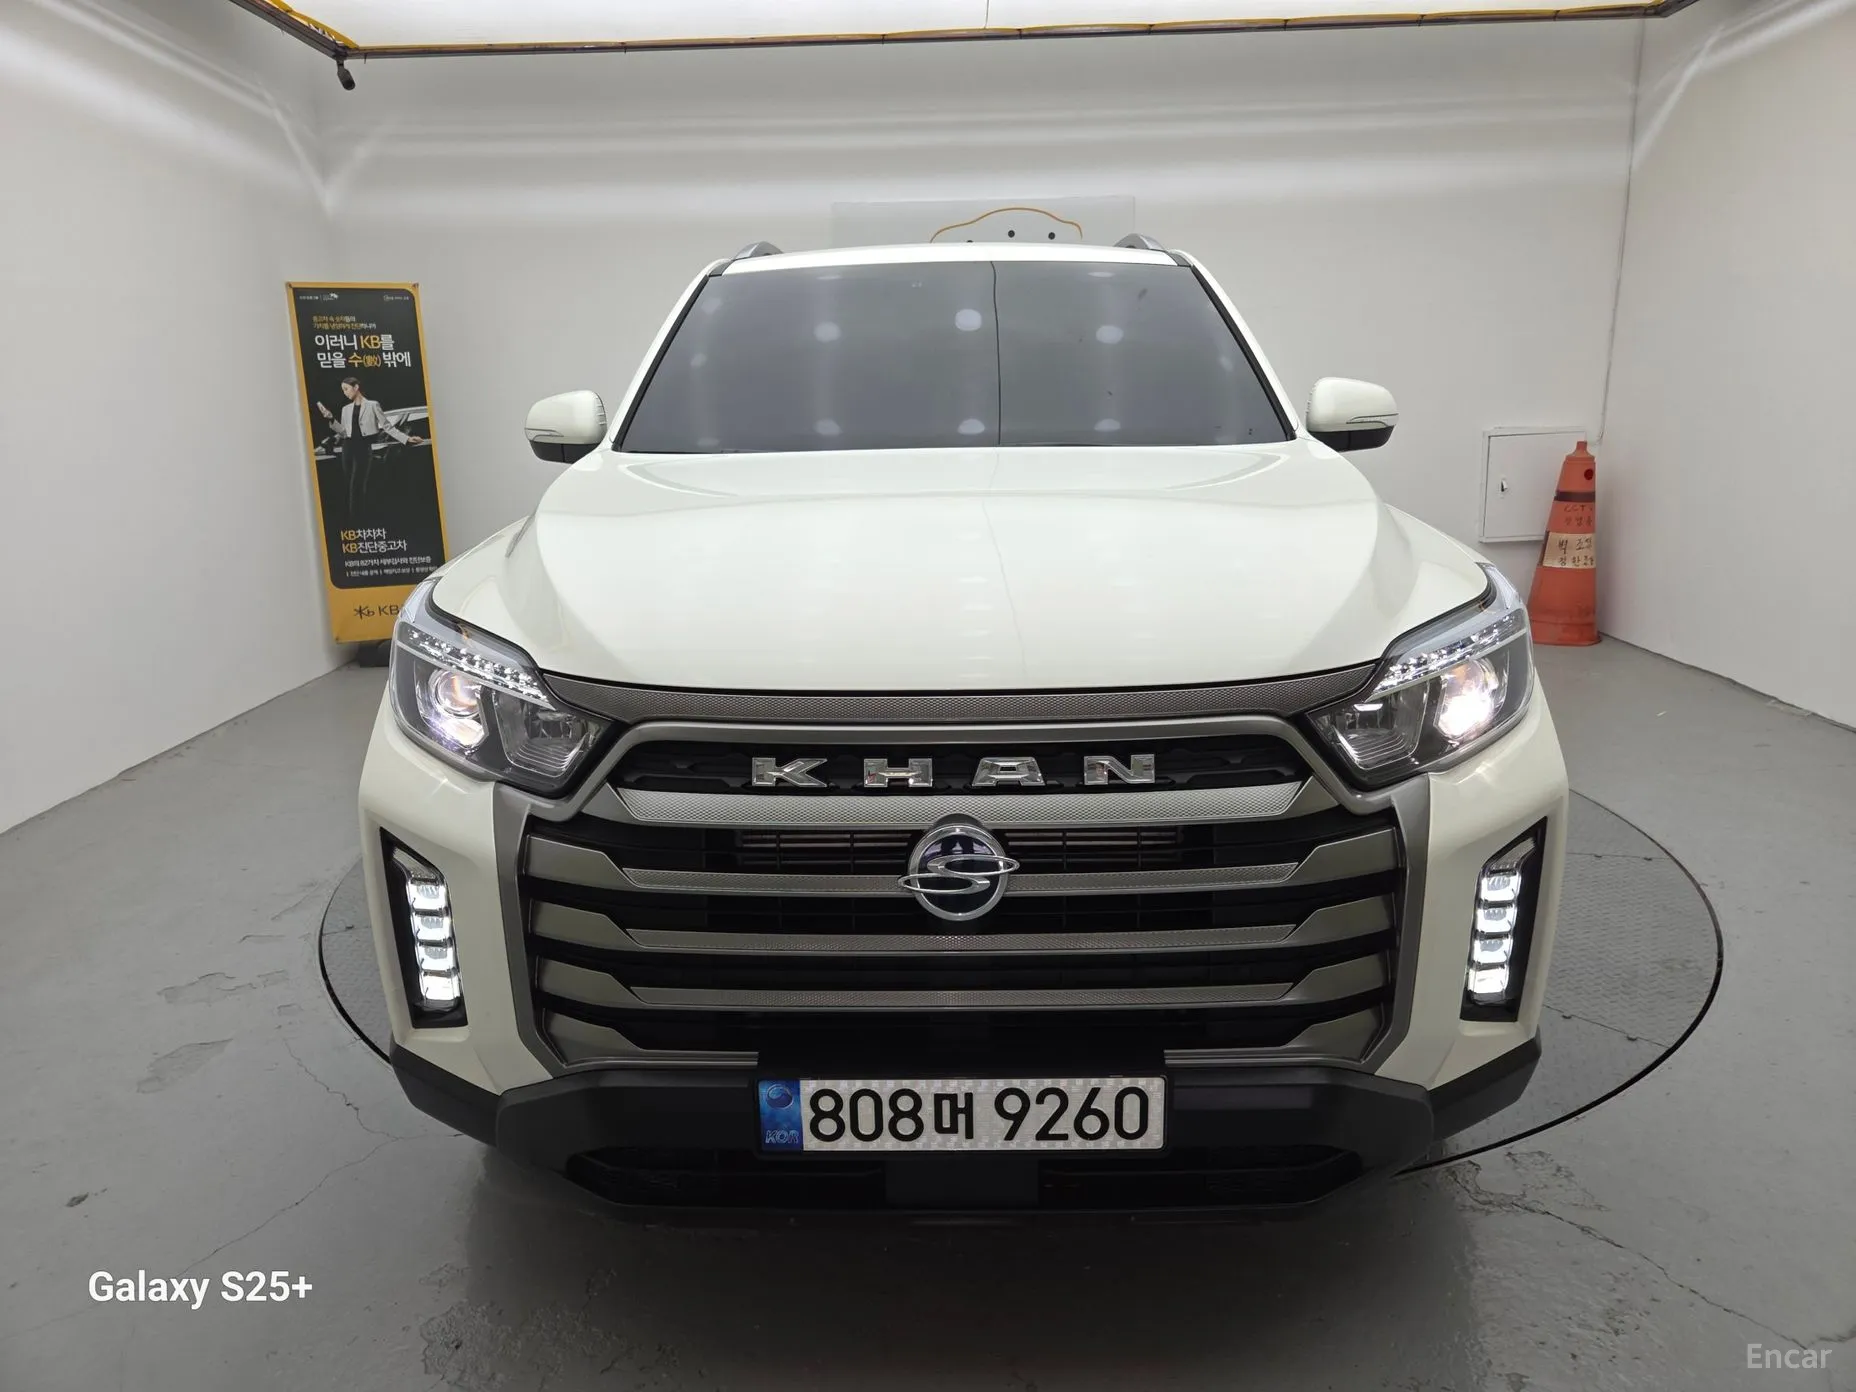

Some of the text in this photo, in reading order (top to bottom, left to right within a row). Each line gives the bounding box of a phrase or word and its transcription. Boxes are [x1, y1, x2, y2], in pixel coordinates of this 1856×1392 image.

[314, 334, 395, 351] 이러니 KB를
[317, 352, 347, 369] 믿을
[382, 351, 412, 368] 밖에
[341, 528, 387, 541] KB차차차
[342, 540, 408, 554] KB진단중고차
[751, 753, 1156, 788] KHAN
[809, 1086, 1149, 1142] 808머 9260
[764, 1129, 800, 1145] KOR
